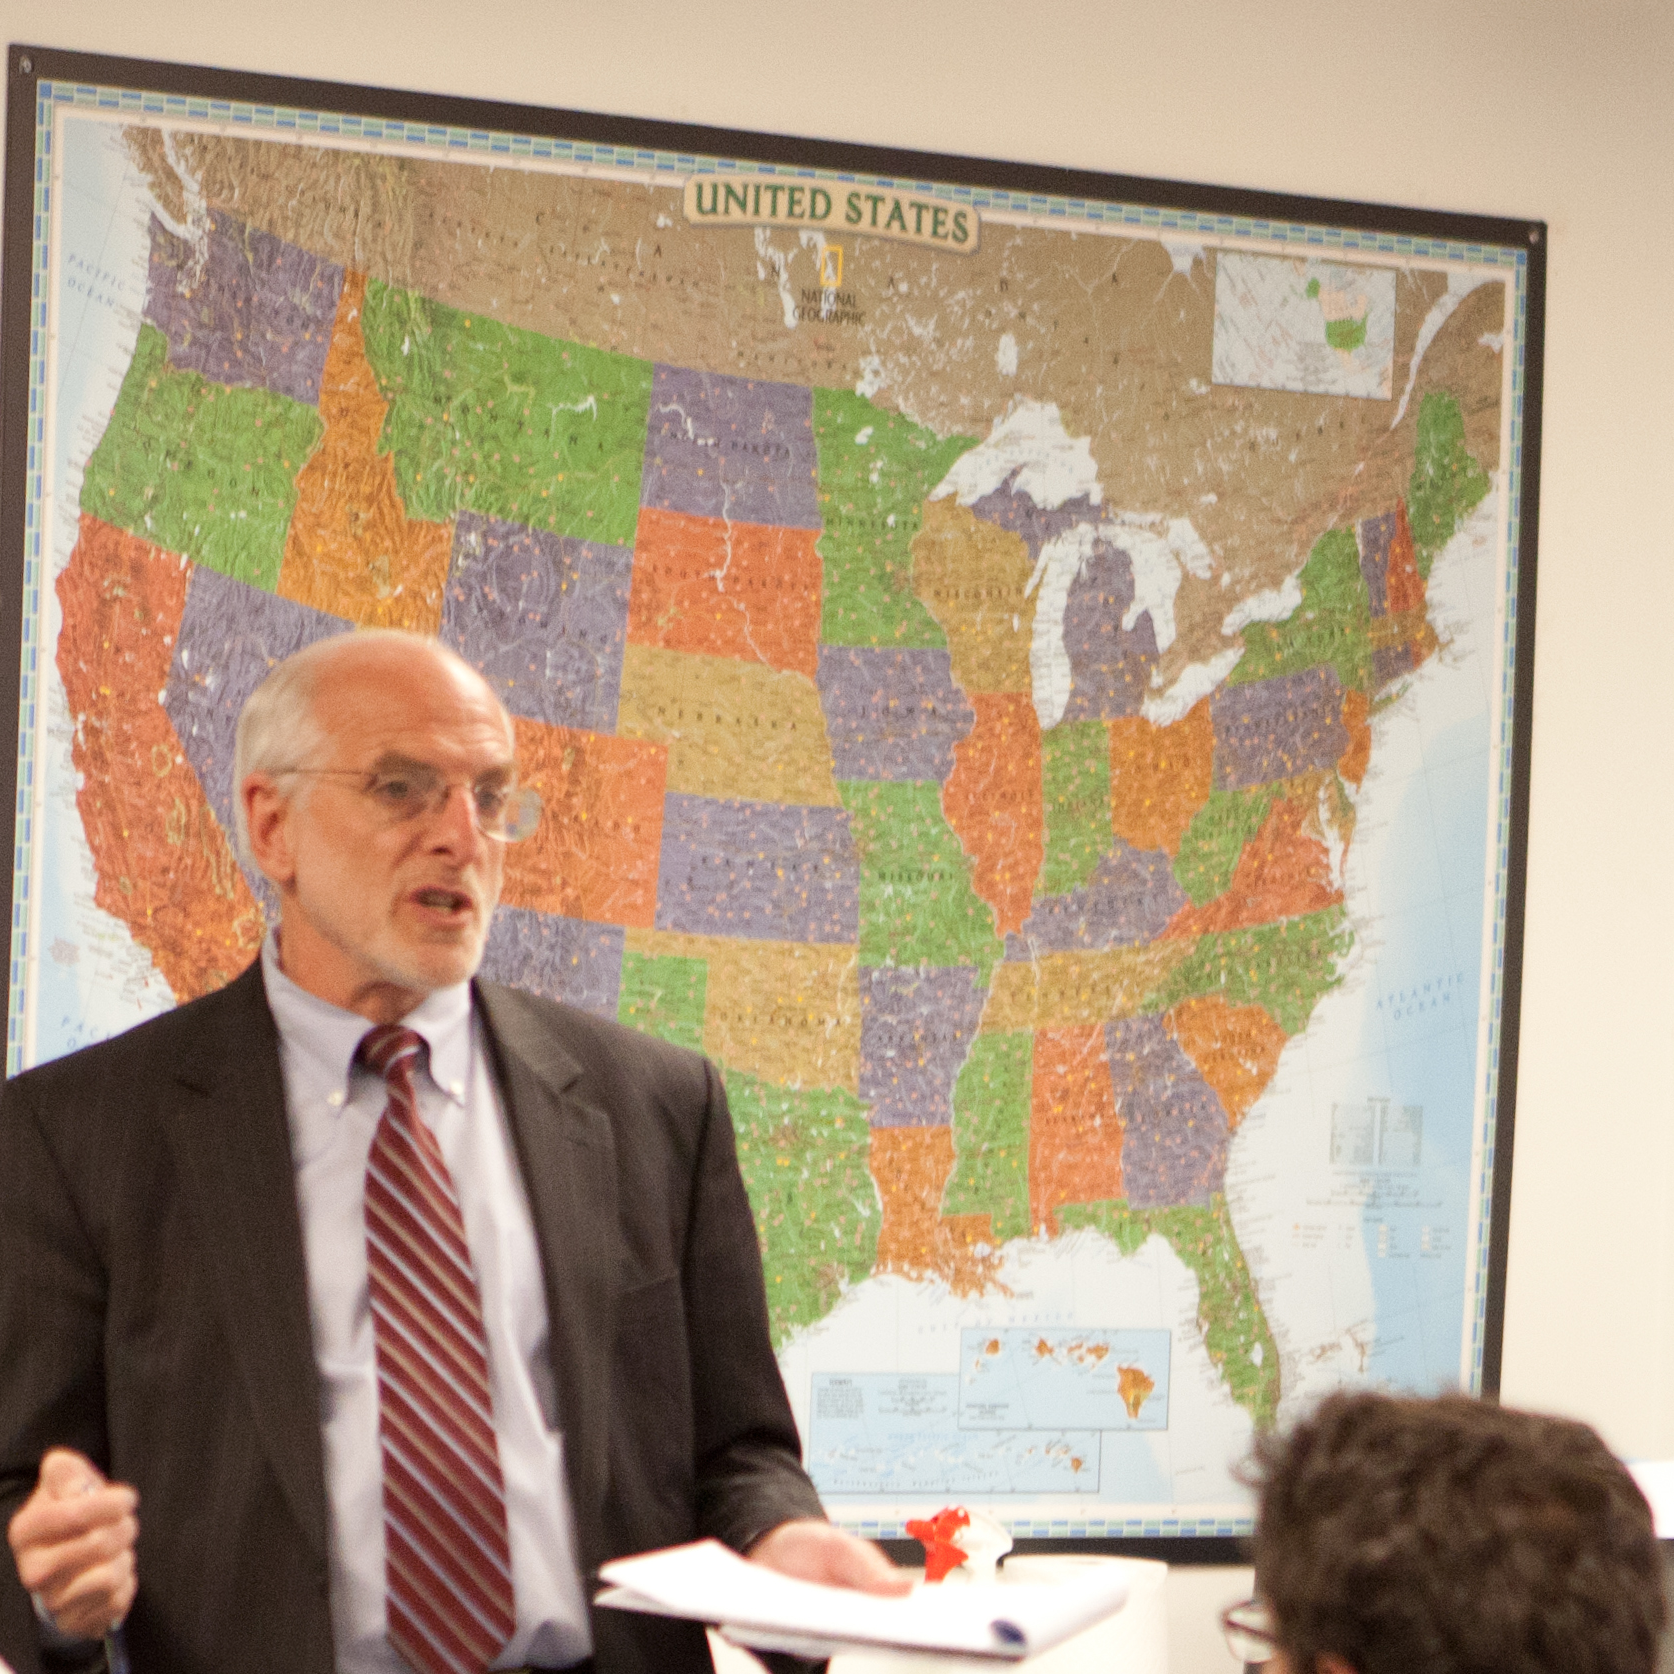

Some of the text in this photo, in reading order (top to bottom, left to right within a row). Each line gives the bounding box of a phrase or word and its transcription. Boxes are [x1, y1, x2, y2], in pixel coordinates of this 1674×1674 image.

[695, 180, 970, 244] UNITED STATES
[801, 287, 857, 309] NATIONAL
[792, 305, 867, 326] GEOGRAPHIC
[1393, 991, 1451, 1021] OCEAN
